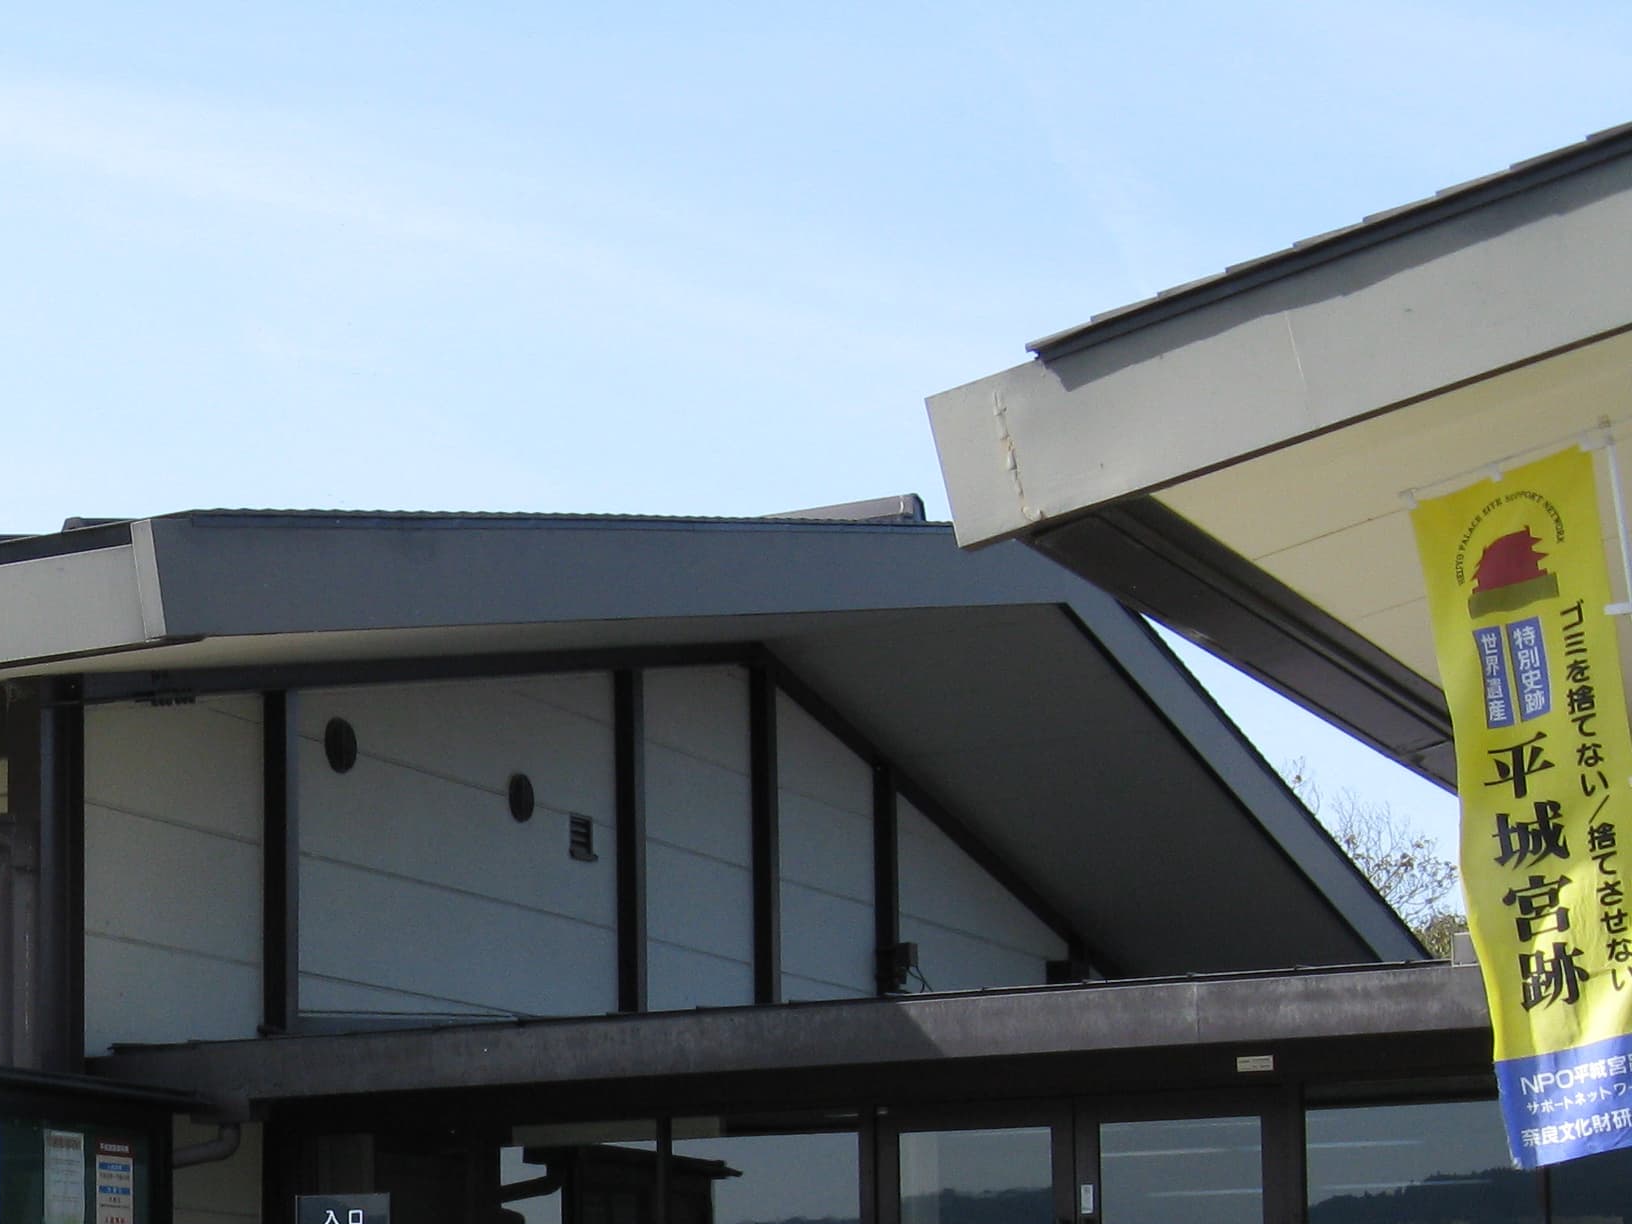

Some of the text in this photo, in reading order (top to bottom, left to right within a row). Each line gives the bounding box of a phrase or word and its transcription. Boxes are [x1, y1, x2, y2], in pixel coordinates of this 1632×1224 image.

[1458, 514, 1482, 552] PALACE
[1482, 497, 1503, 517] SITE
[1480, 632, 1508, 723] 世界遺産
[1513, 626, 1547, 714] 特別史跡
[1483, 730, 1590, 1012] 平城宮跡
[1520, 1052, 1632, 1096] NPO平城宮
